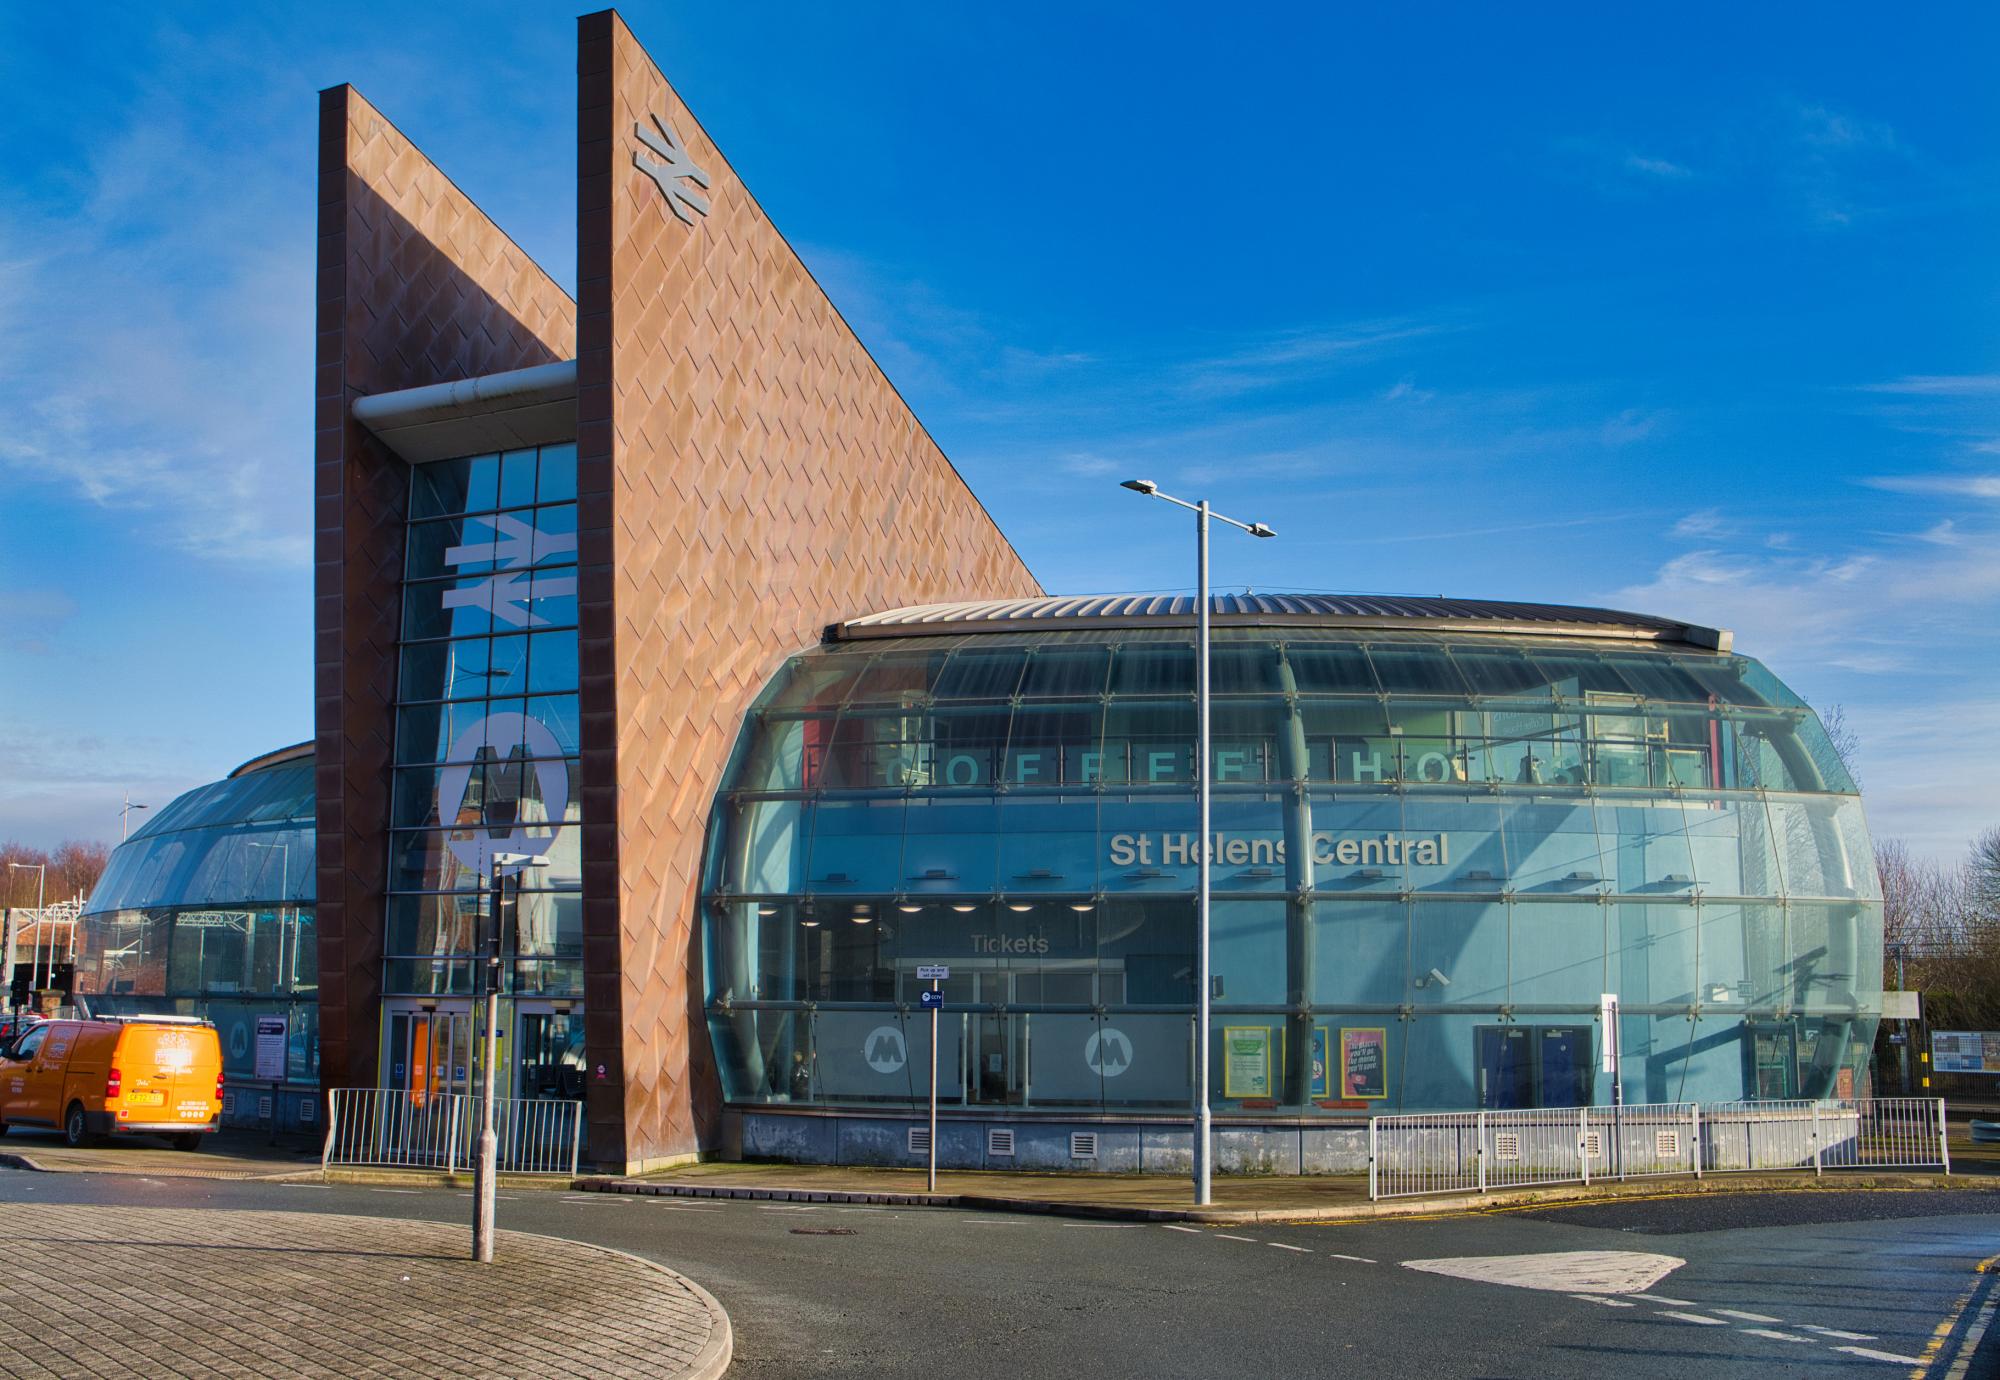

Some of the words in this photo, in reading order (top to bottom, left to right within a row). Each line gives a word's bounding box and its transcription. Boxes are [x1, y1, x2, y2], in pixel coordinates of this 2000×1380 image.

[1110, 833, 1151, 866] St
[1311, 832, 1448, 866] Central
[970, 933, 1049, 953] Tickets
